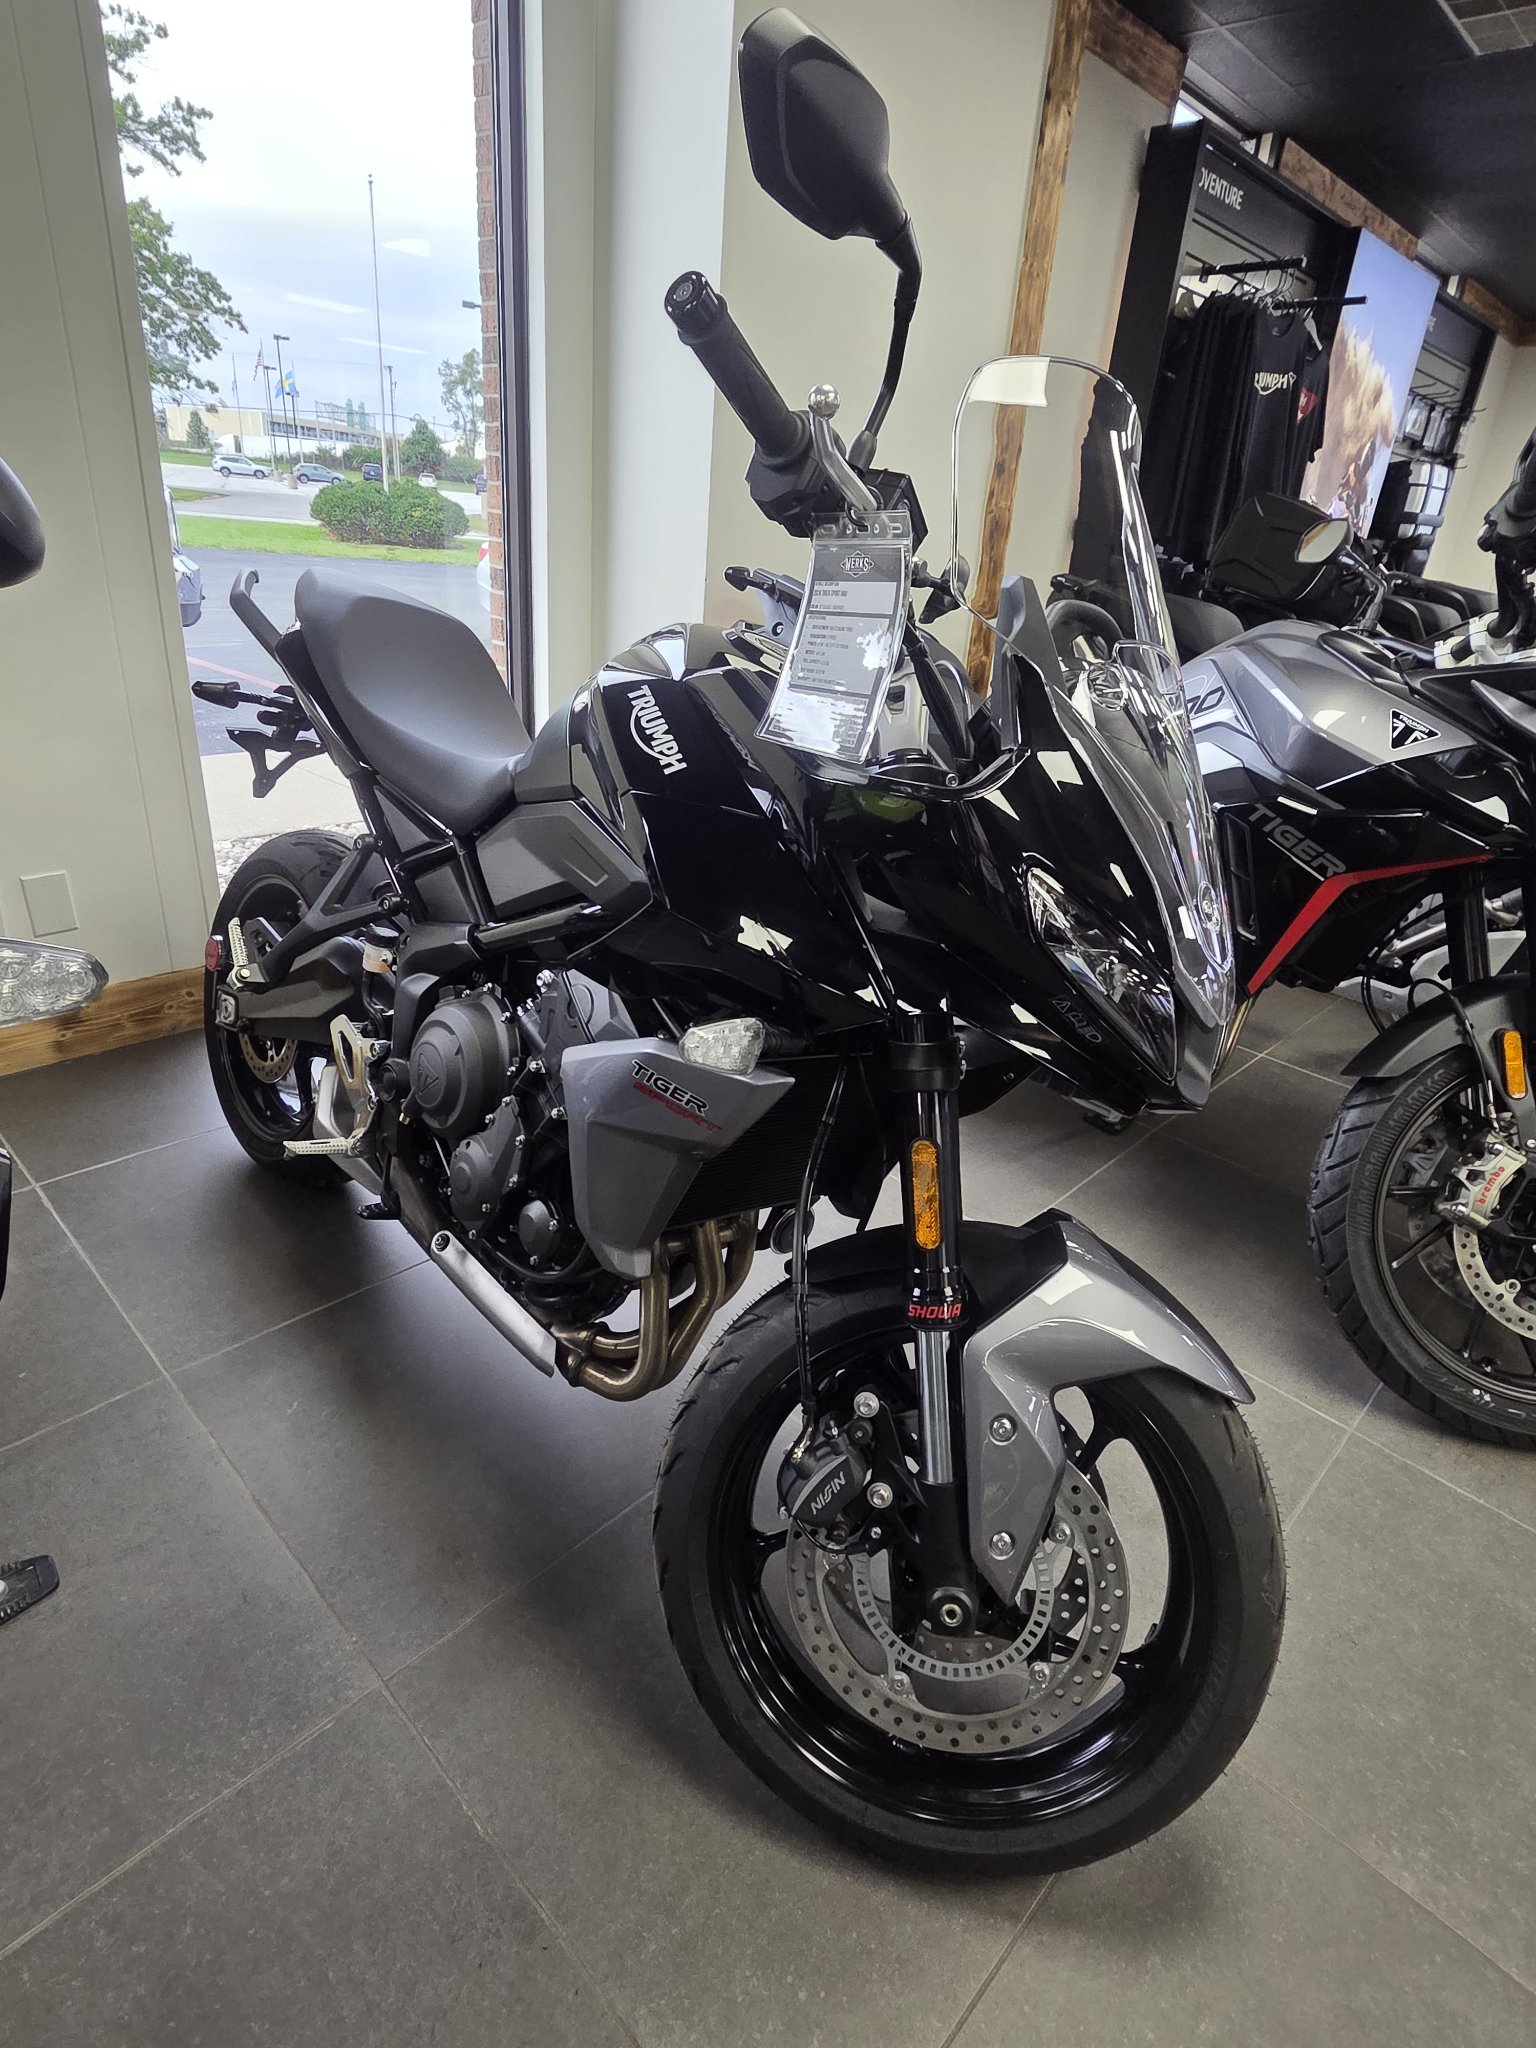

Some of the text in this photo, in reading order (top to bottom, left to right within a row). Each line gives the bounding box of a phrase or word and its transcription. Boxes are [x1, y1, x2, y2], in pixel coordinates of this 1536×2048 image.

[845, 557, 869, 571] WERKS
[626, 684, 688, 775] TRIUMPH
[1248, 803, 1347, 877] TIGER
[631, 1059, 708, 1116] TIGER
[1476, 1166, 1505, 1205] brembo
[907, 1303, 961, 1319] SHOWA
[810, 1471, 846, 1515] NISSIN
